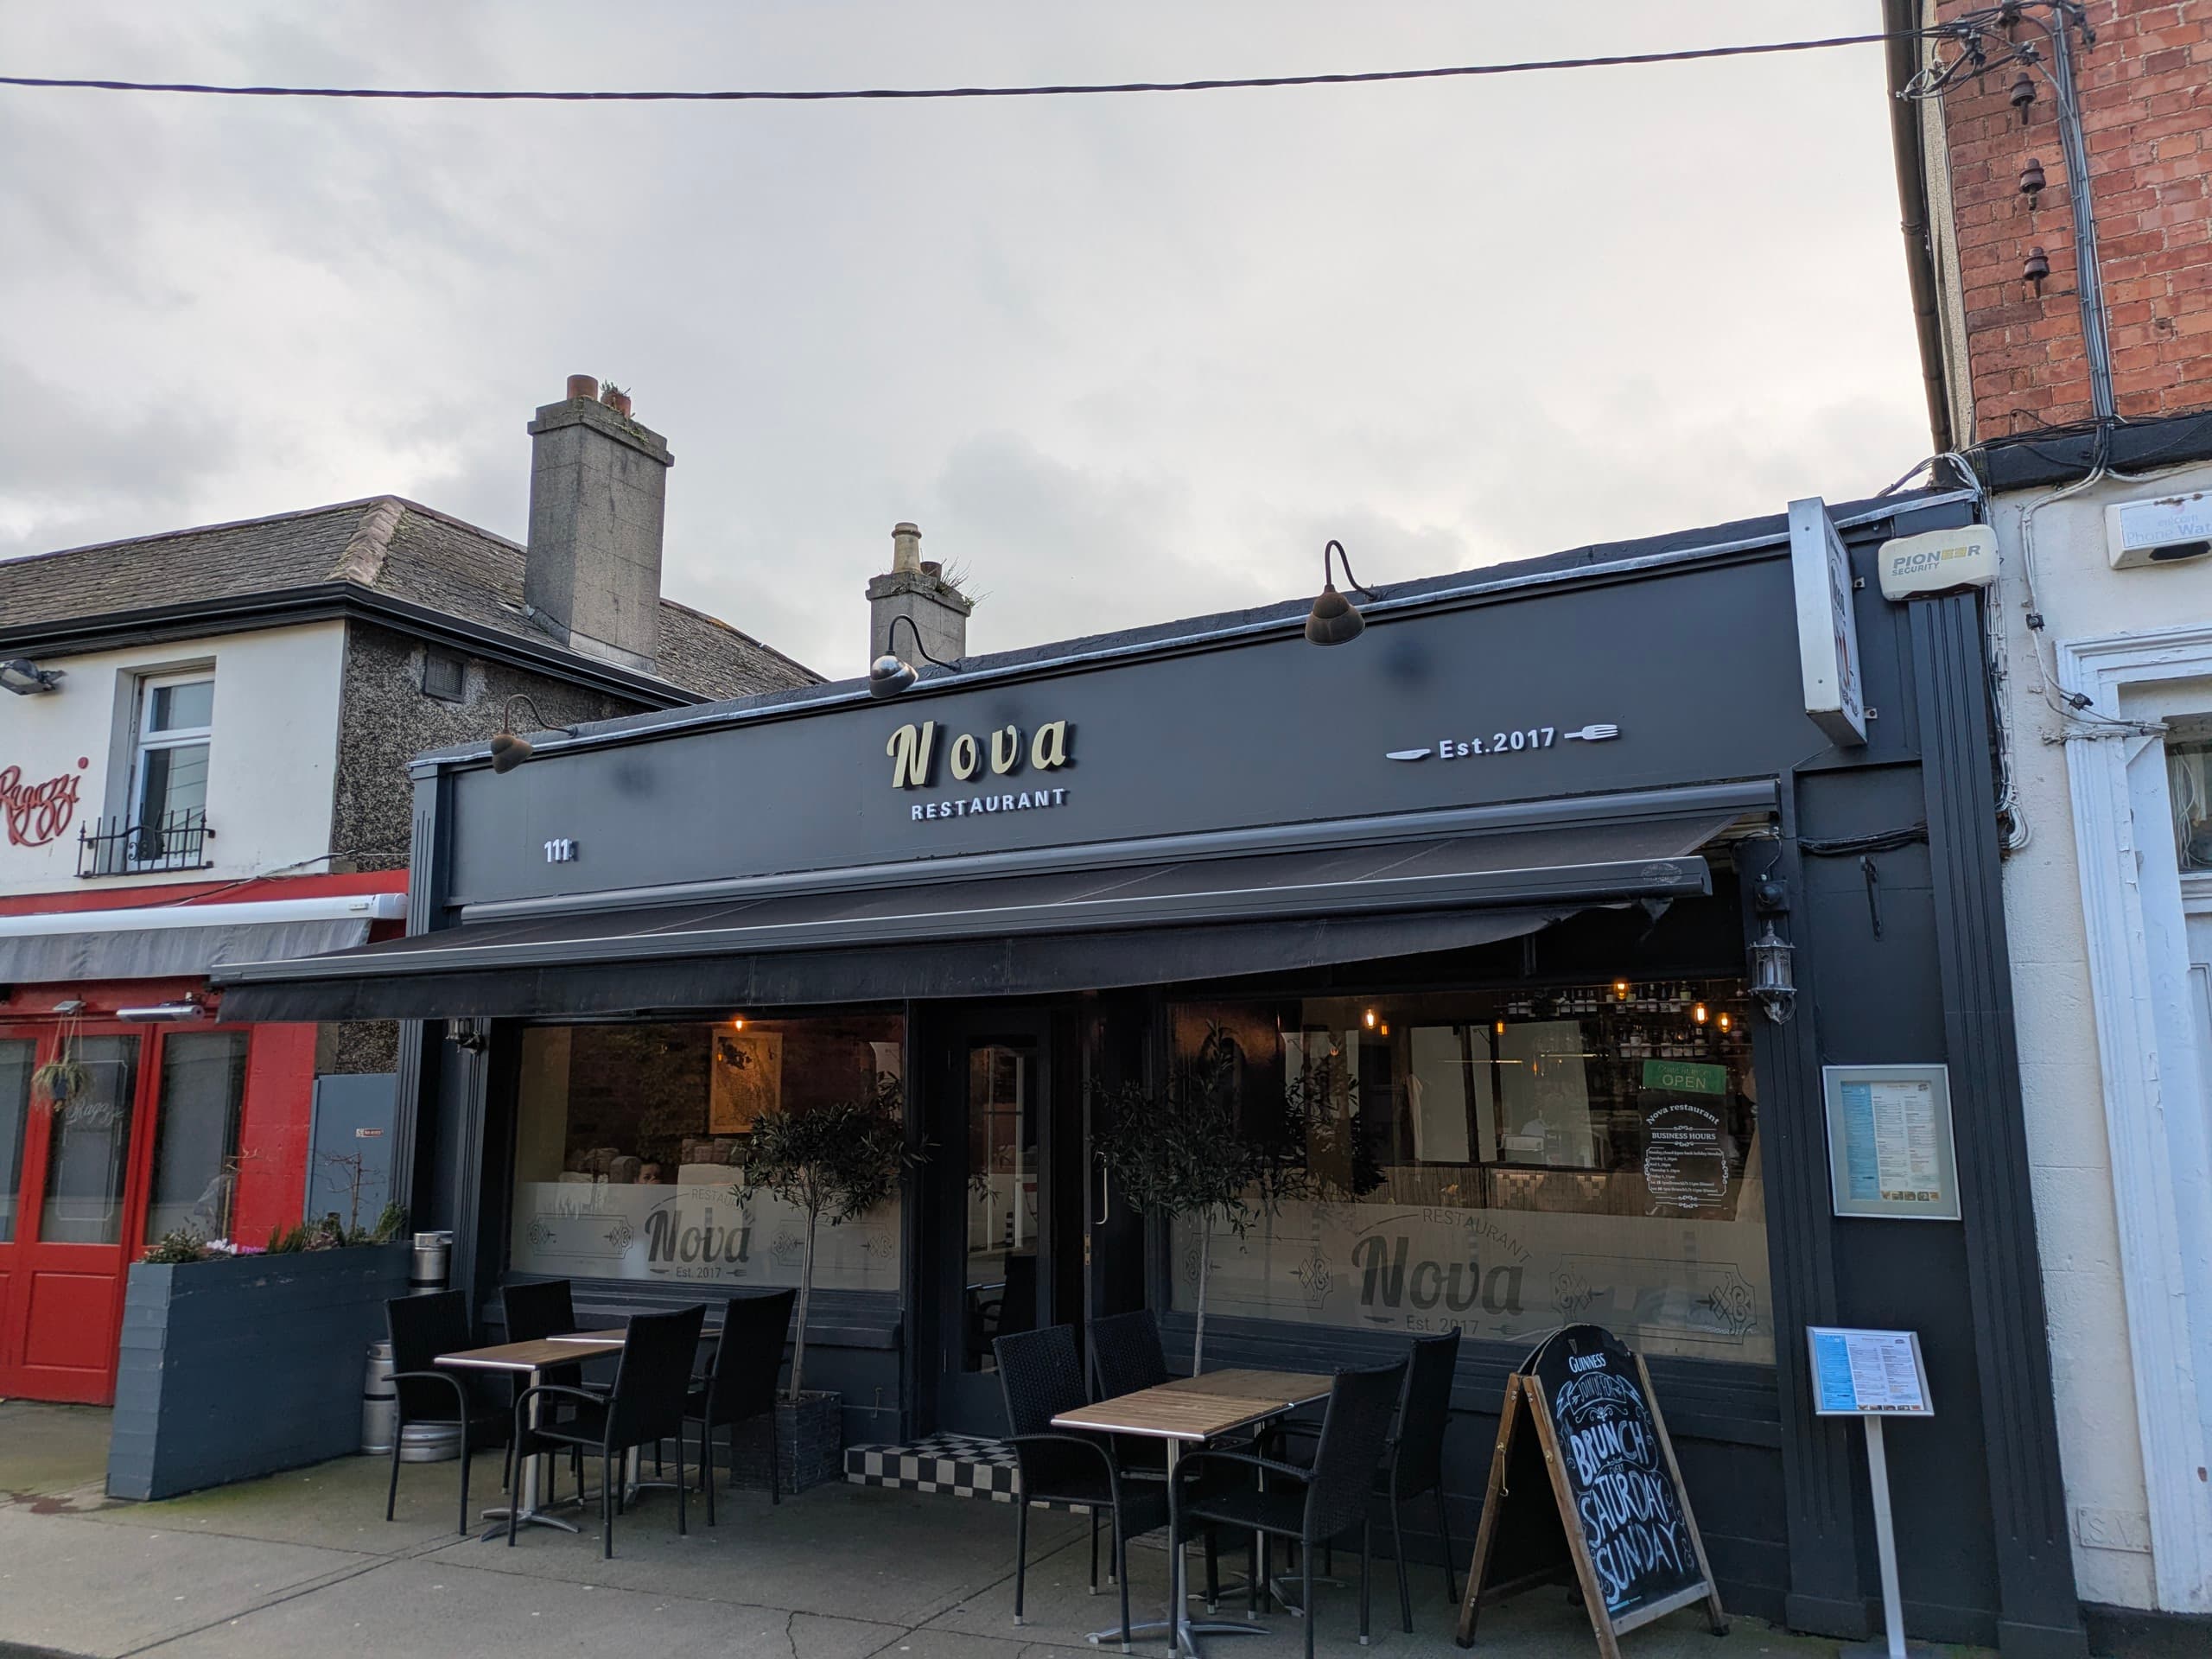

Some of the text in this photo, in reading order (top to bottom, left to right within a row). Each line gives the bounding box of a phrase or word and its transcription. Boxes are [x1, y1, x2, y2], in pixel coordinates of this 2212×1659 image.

[1891, 563, 1940, 576] SECURITY
[1892, 544, 1981, 569] PIONEER
[887, 720, 1068, 789] Nova
[1439, 727, 1555, 760] Est.2017
[911, 788, 1065, 821] RESTAURANT
[1662, 1074, 1707, 1090] OPEN
[1646, 1104, 1719, 1125] Nova restaurant
[1651, 1132, 1716, 1141] BUSINESS HOURS
[645, 1209, 751, 1262] Nova
[1423, 1208, 1533, 1264] RESTAURANT
[677, 1267, 721, 1279] Est. 2017
[1351, 1235, 1524, 1316] Nova
[1406, 1314, 1479, 1335] Est. 2017
[1568, 1352, 1606, 1373] GUINNESS
[1569, 1420, 1649, 1487] BRUNCH
[1580, 1471, 1670, 1549] SATURDAY
[1596, 1520, 1684, 1605] SUNDAY
